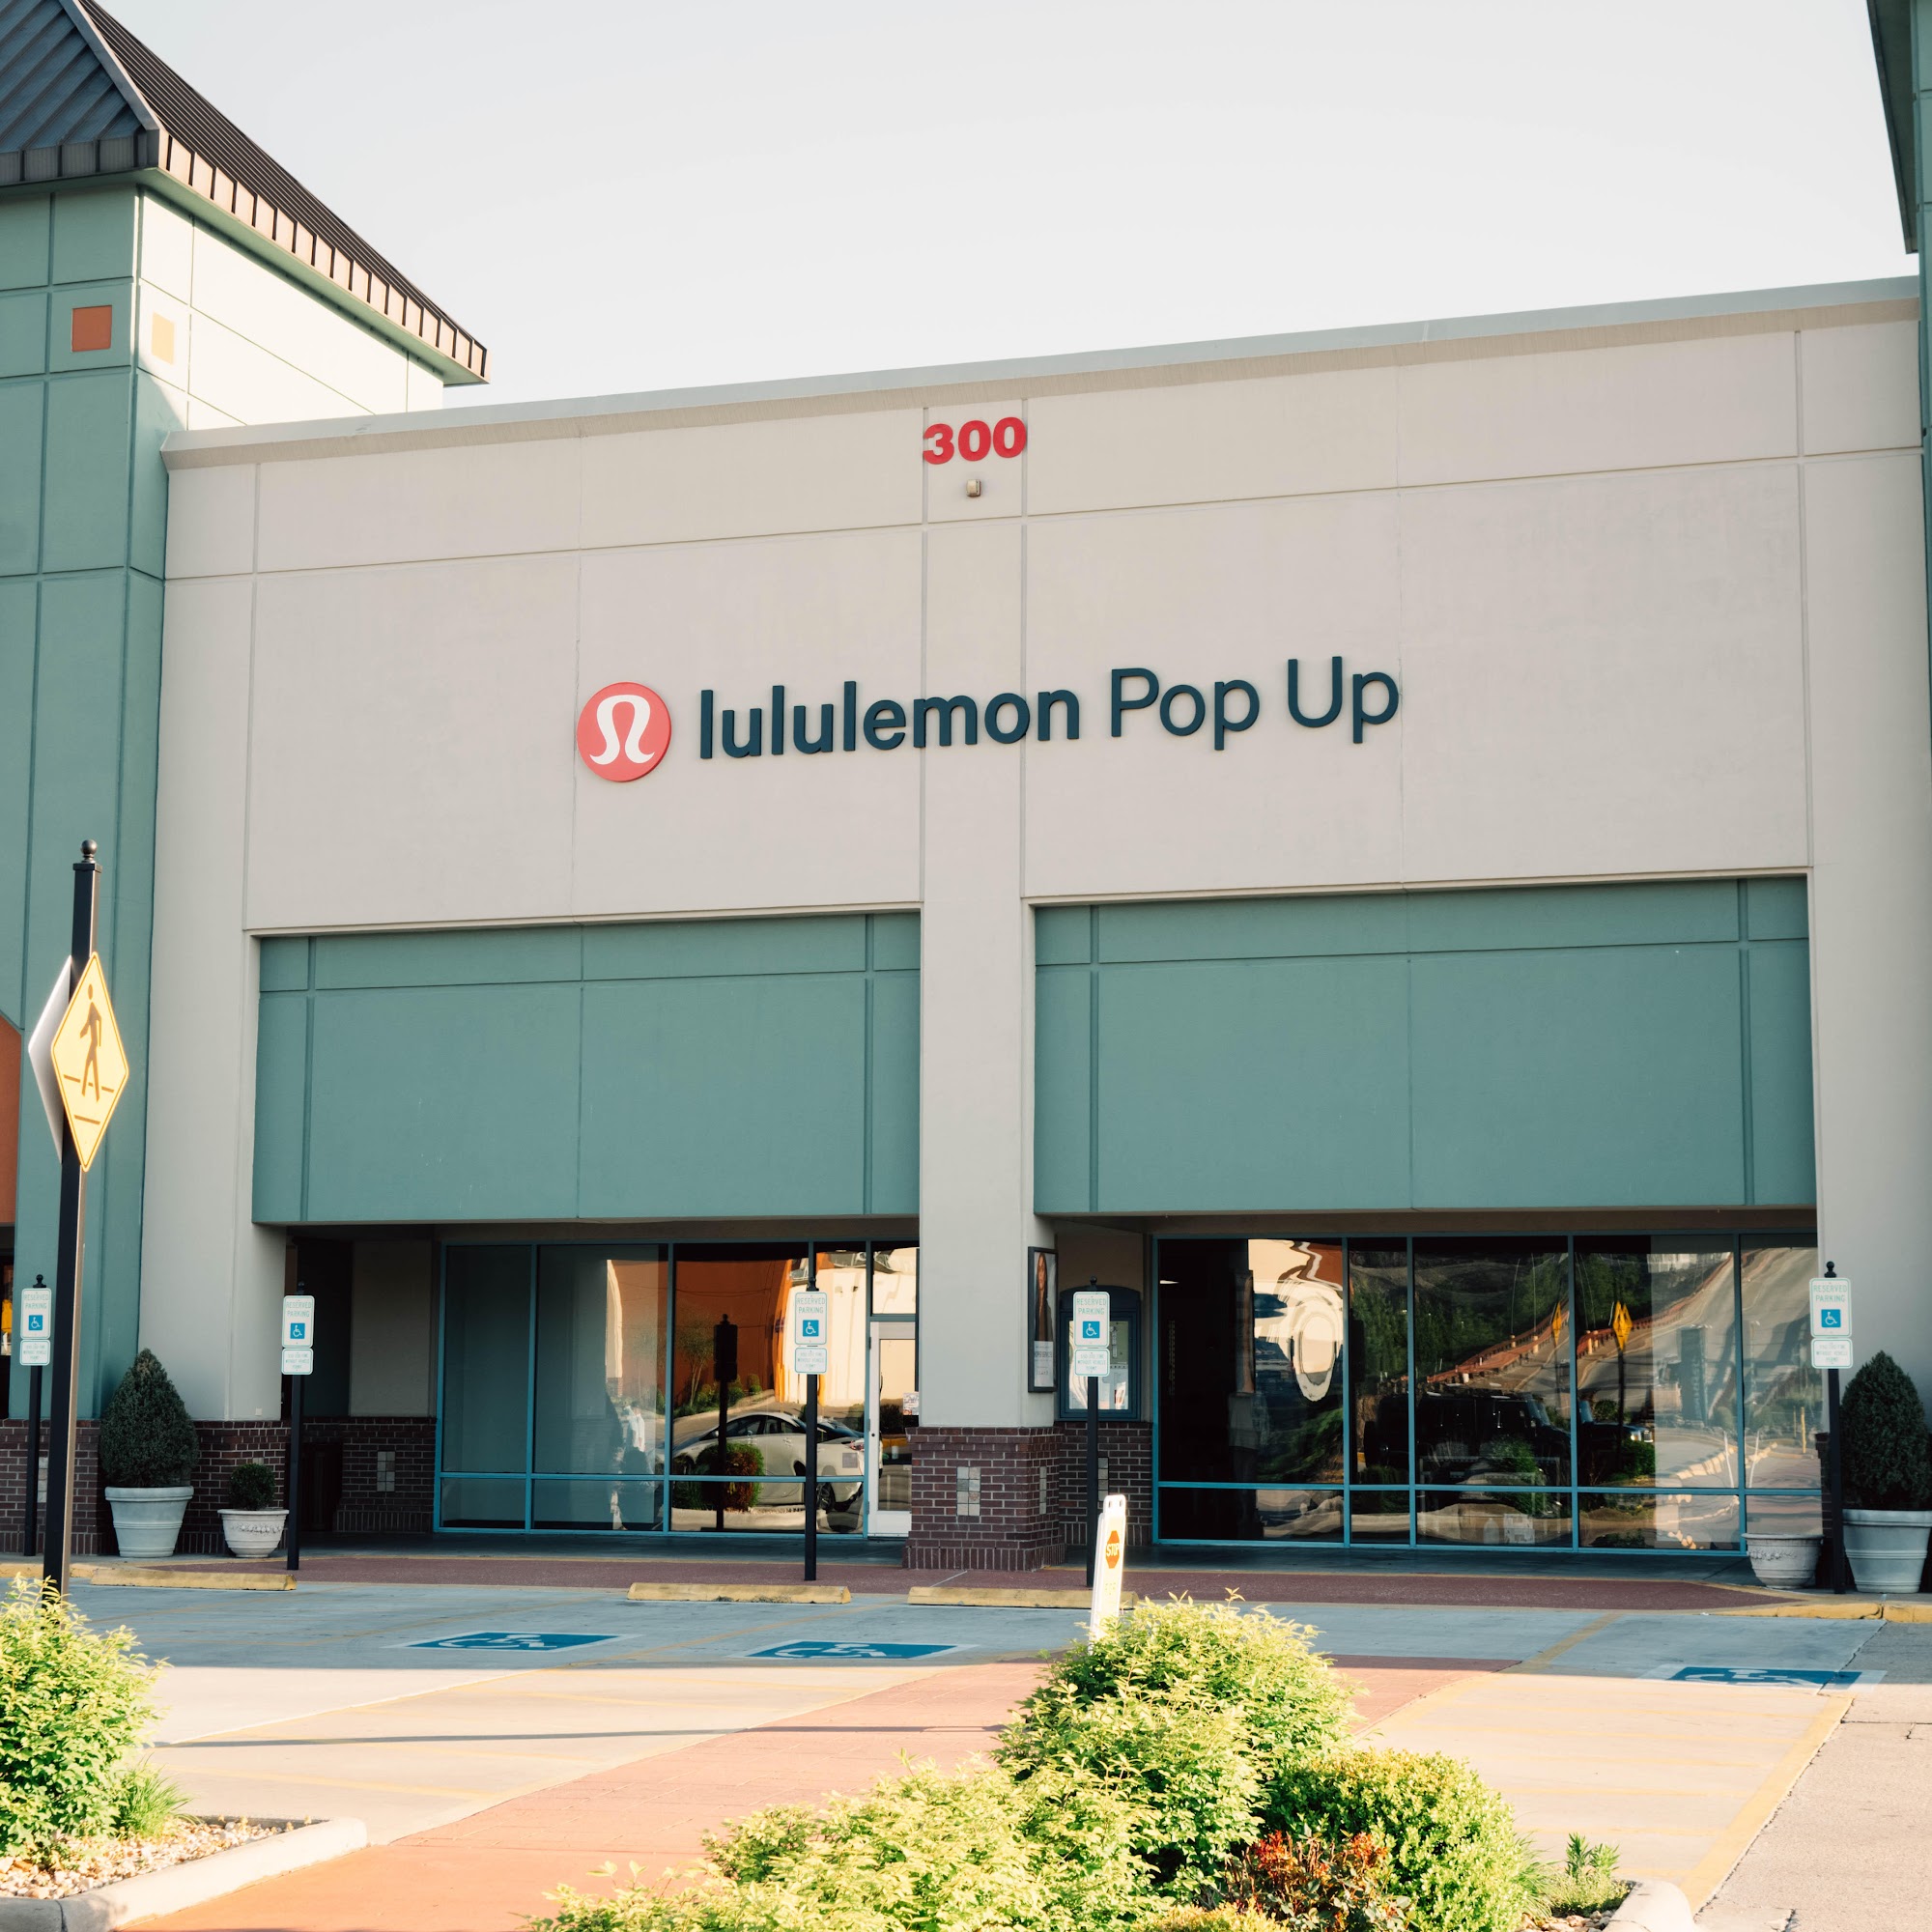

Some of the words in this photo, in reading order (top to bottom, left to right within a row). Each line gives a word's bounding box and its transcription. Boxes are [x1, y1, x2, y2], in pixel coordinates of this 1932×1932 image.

[923, 416, 1027, 465] 300
[700, 680, 1080, 759] lululemon
[1111, 668, 1260, 751] Pop
[1288, 656, 1399, 744] Up
[1813, 1284, 1847, 1293] RESERVED
[1077, 1297, 1107, 1306] RESERVED
[1105, 1543, 1121, 1557] STOP
